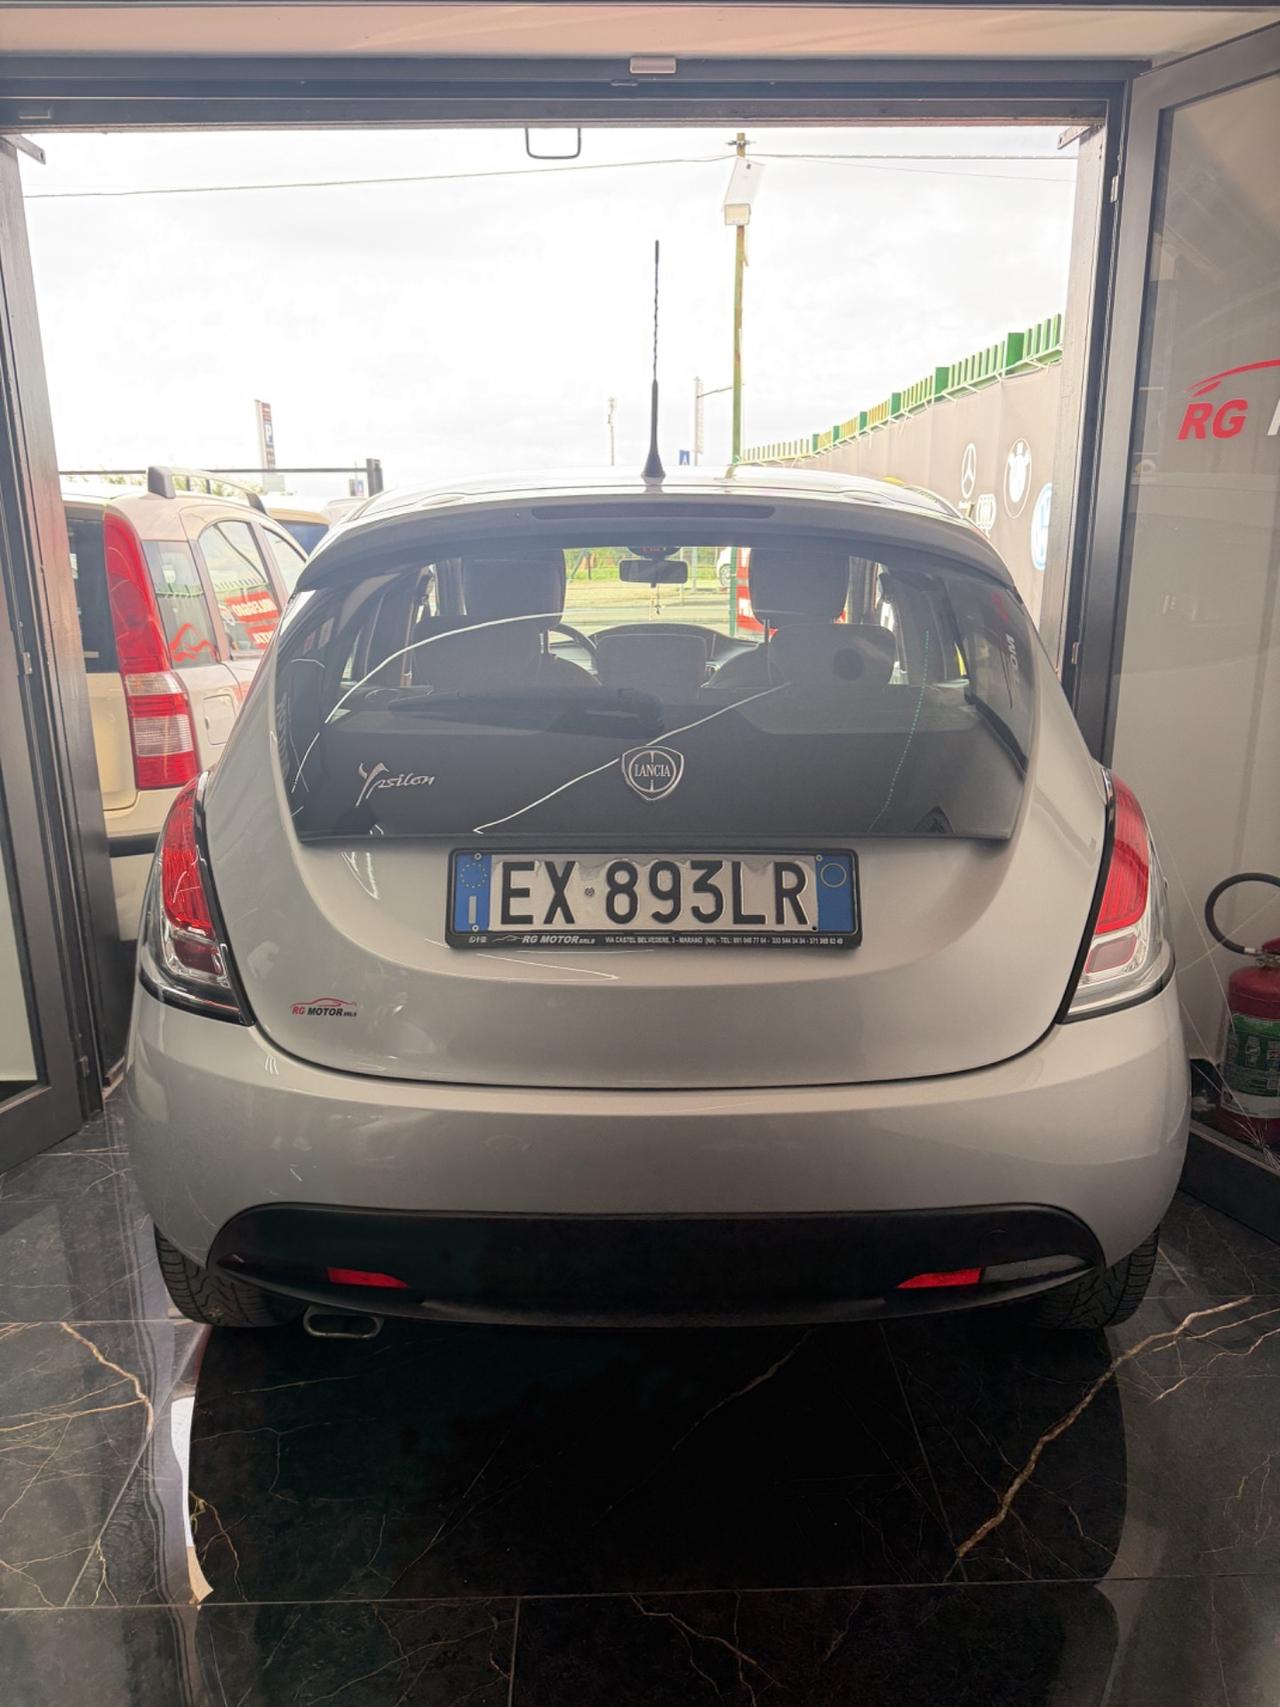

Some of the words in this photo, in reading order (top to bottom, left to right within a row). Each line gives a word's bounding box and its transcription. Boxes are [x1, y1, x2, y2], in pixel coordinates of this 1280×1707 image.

[1177, 398, 1249, 440] RG
[634, 763, 671, 777] LANCIA
[355, 761, 436, 808] Ypsilon
[521, 935, 538, 943] RG
[292, 1006, 305, 1015] RG
[307, 1007, 343, 1016] MOTOR
